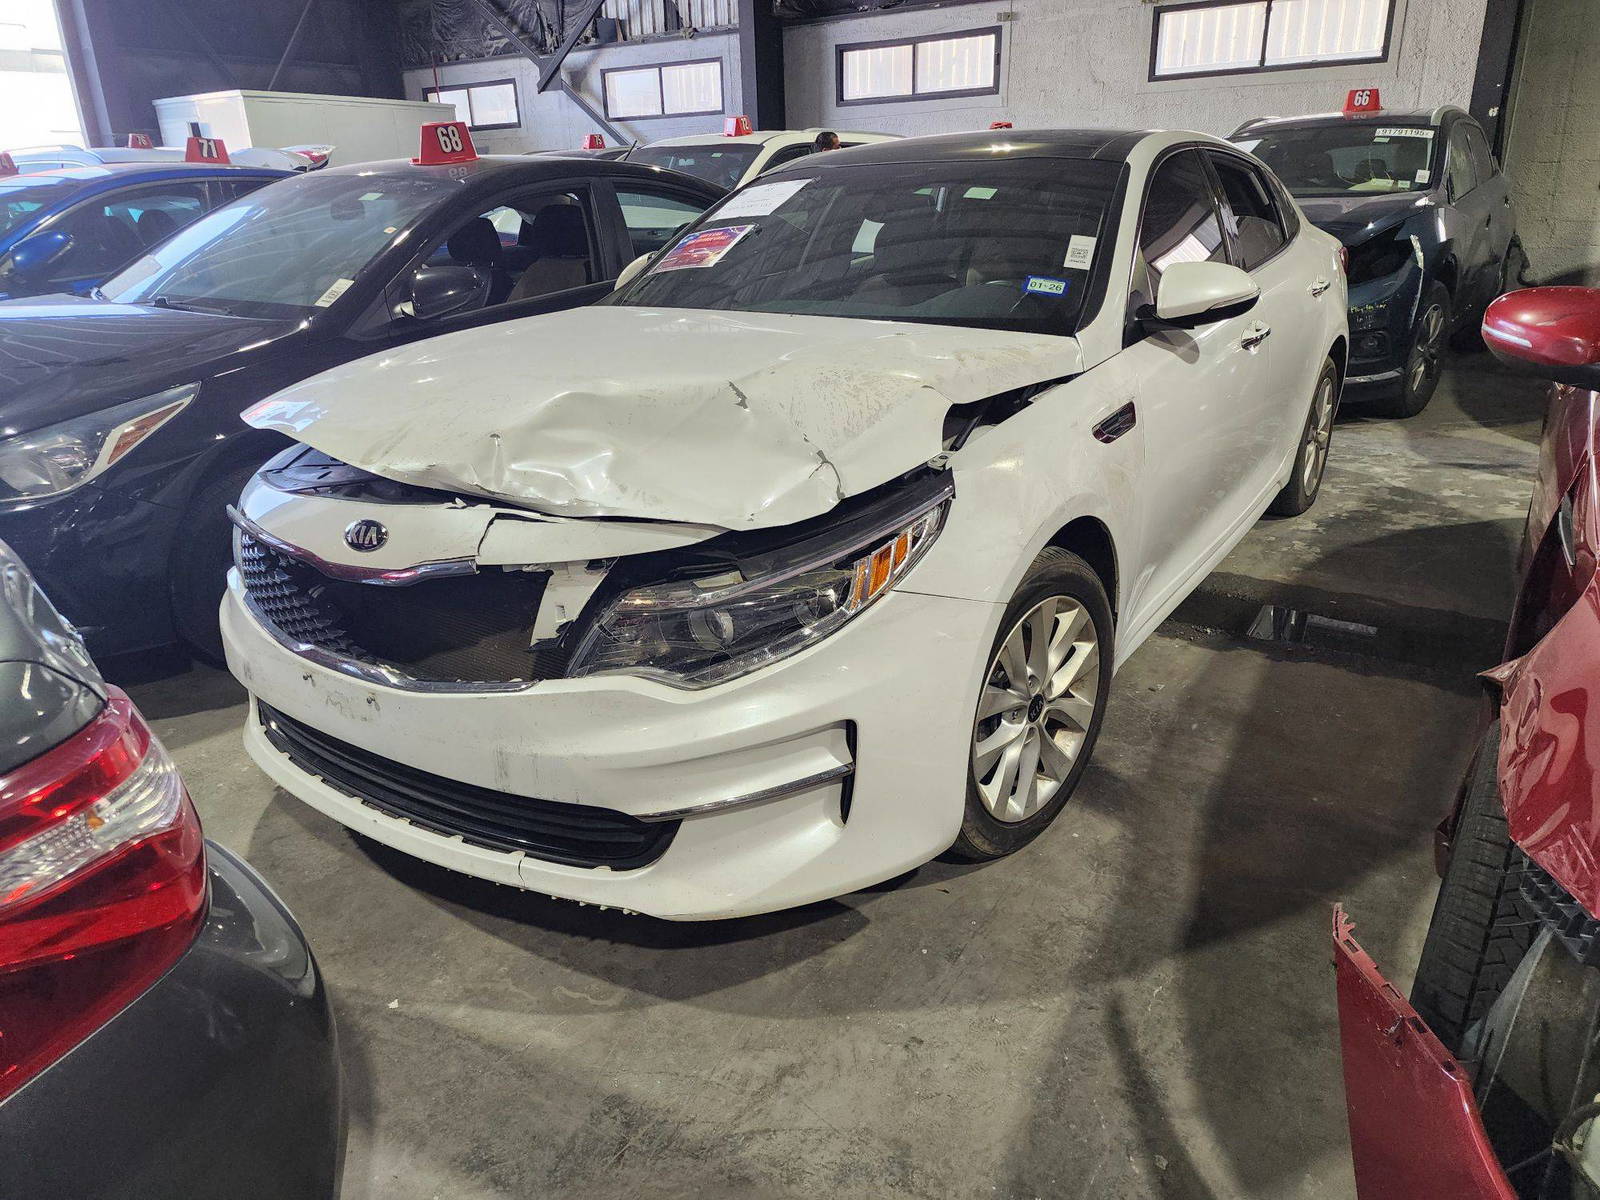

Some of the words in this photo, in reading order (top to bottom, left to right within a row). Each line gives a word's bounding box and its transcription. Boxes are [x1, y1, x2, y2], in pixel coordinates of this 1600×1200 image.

[1353, 90, 1370, 106] 66
[198, 139, 218, 158] 71
[436, 125, 464, 153] 68
[351, 525, 378, 545] KIA
